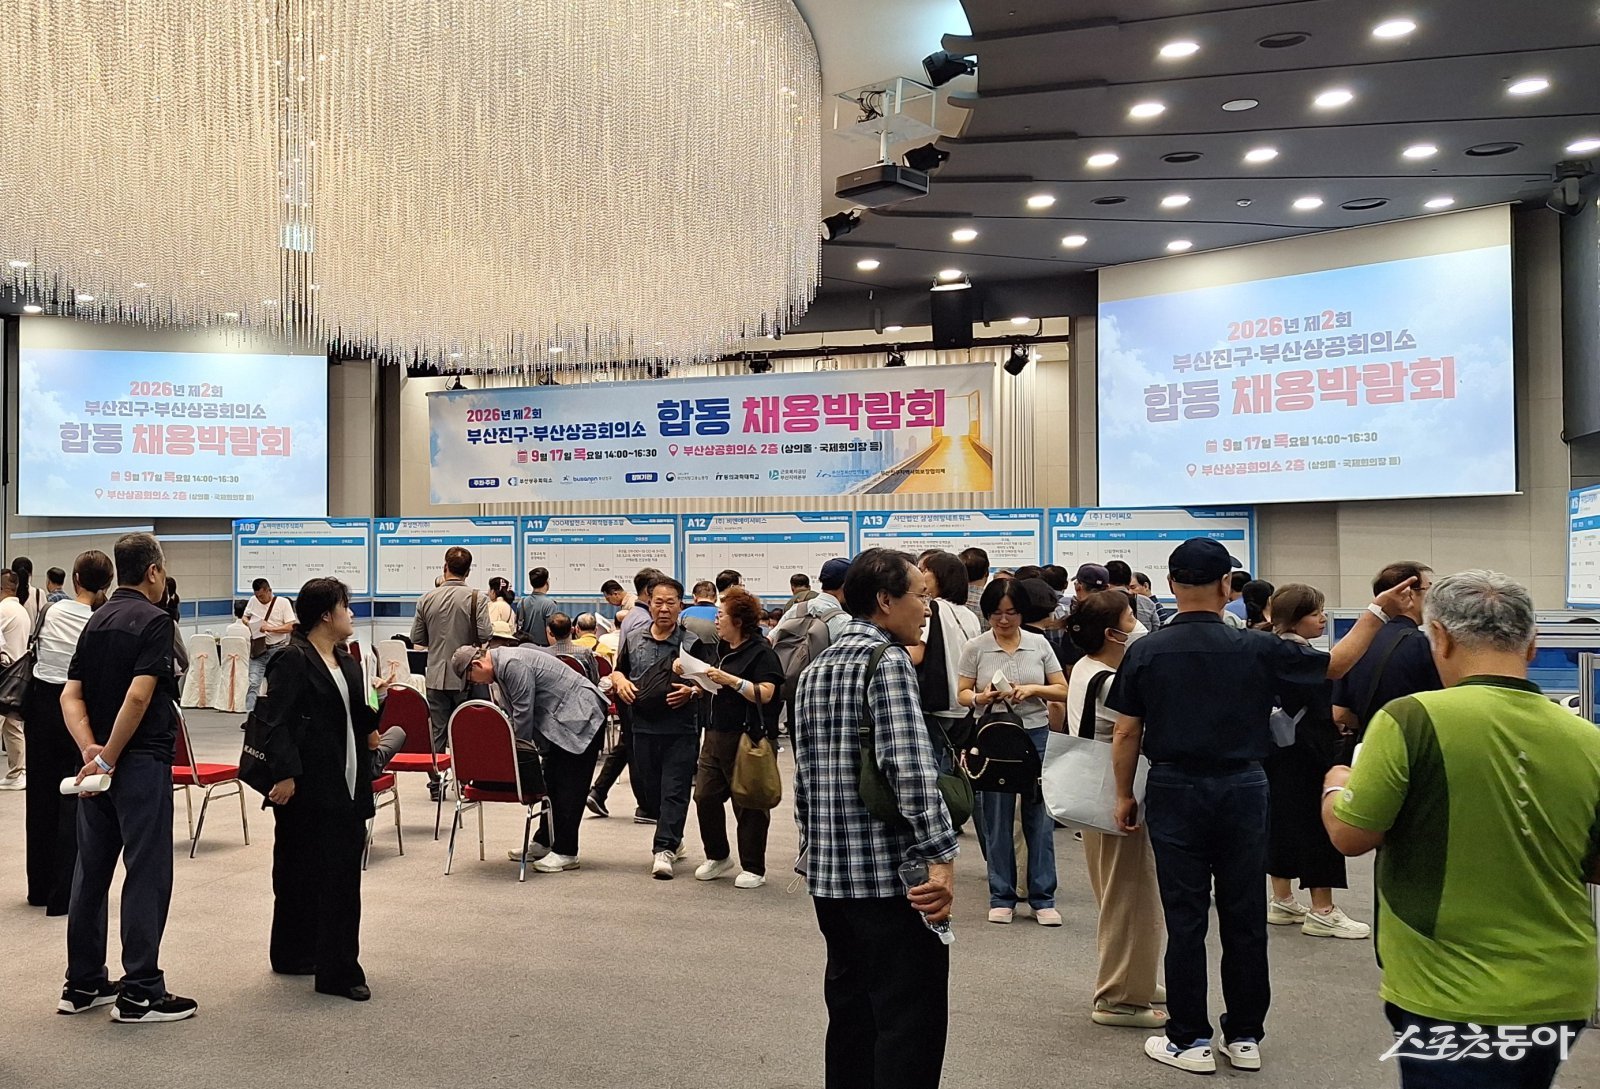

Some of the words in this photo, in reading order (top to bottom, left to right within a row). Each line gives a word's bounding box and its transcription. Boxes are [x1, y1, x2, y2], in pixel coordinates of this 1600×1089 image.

[1227, 316, 1300, 341] 2026년
[1303, 309, 1352, 332] 제2회
[1172, 328, 1417, 373] 부산진구·부산상공회의소
[129, 380, 185, 398] 2026년
[188, 382, 223, 398] 제2회
[1143, 379, 1220, 423] 합동
[1231, 356, 1456, 415] 채용박람회
[84, 400, 267, 420] 부산진구·부산상공회의소
[466, 407, 511, 423] 2026년
[513, 407, 542, 420] 제2회
[656, 397, 731, 437] 합동
[742, 388, 946, 434] 채용박람회
[59, 422, 123, 454] 합동
[132, 422, 292, 457] 채용박람회
[466, 420, 647, 445] 부산진구·부산상공회의소
[683, 443, 758, 456] 부산상공회의소
[760, 443, 778, 455] 2층
[781, 442, 812, 454] (상의홀
[819, 441, 867, 453] 국제회의장
[869, 441, 883, 452] 등)
[1222, 438, 1242, 452] 9월
[1244, 436, 1271, 451] 17일
[1273, 433, 1310, 449] 목요일
[1311, 432, 1378, 446] 14:00~16:30
[531, 449, 548, 462] 9월
[549, 449, 572, 462] 17일
[573, 447, 602, 461] 목요일
[604, 448, 657, 460] 14:00~16:30
[1201, 460, 1283, 476] 부산상공회의소
[1285, 459, 1305, 472] 2층
[124, 470, 139, 482] 9월
[141, 471, 162, 482] 17일
[164, 471, 191, 483] 목요일
[192, 474, 239, 483] 14:00~16:30
[107, 489, 171, 500] 부산상공회의소
[172, 490, 187, 501] 2층
[379, 521, 395, 531] A10
[527, 520, 543, 529] A11
[687, 518, 706, 528] A12
[862, 515, 883, 526] A13
[893, 514, 919, 523] 사단법인
[1055, 513, 1078, 523] A14
[239, 522, 256, 532] A09
